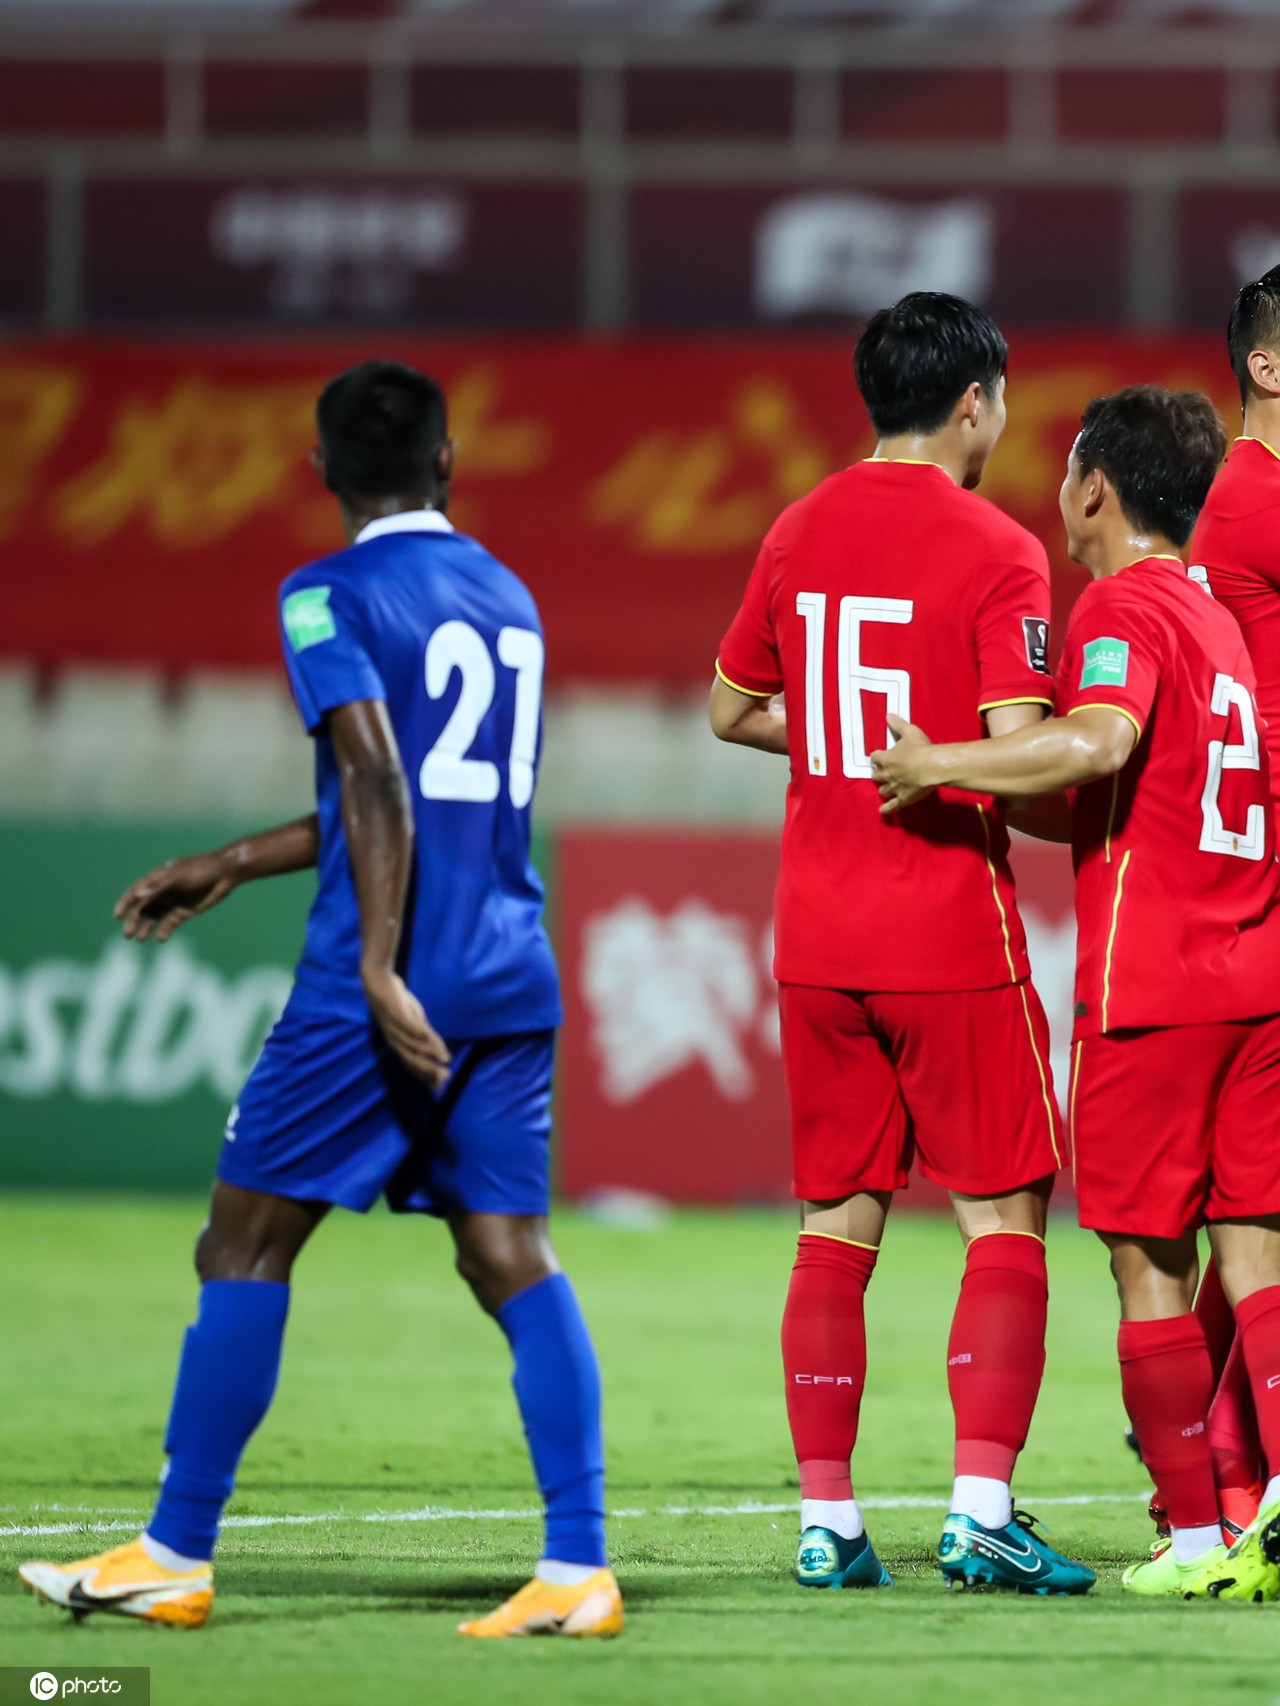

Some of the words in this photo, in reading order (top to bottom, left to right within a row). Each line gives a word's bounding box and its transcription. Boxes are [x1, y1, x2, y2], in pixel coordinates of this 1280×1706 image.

[419, 620, 544, 809] 21
[796, 592, 913, 779] 16
[1199, 672, 1266, 862] 2
[795, 1374, 852, 1385] CFA
